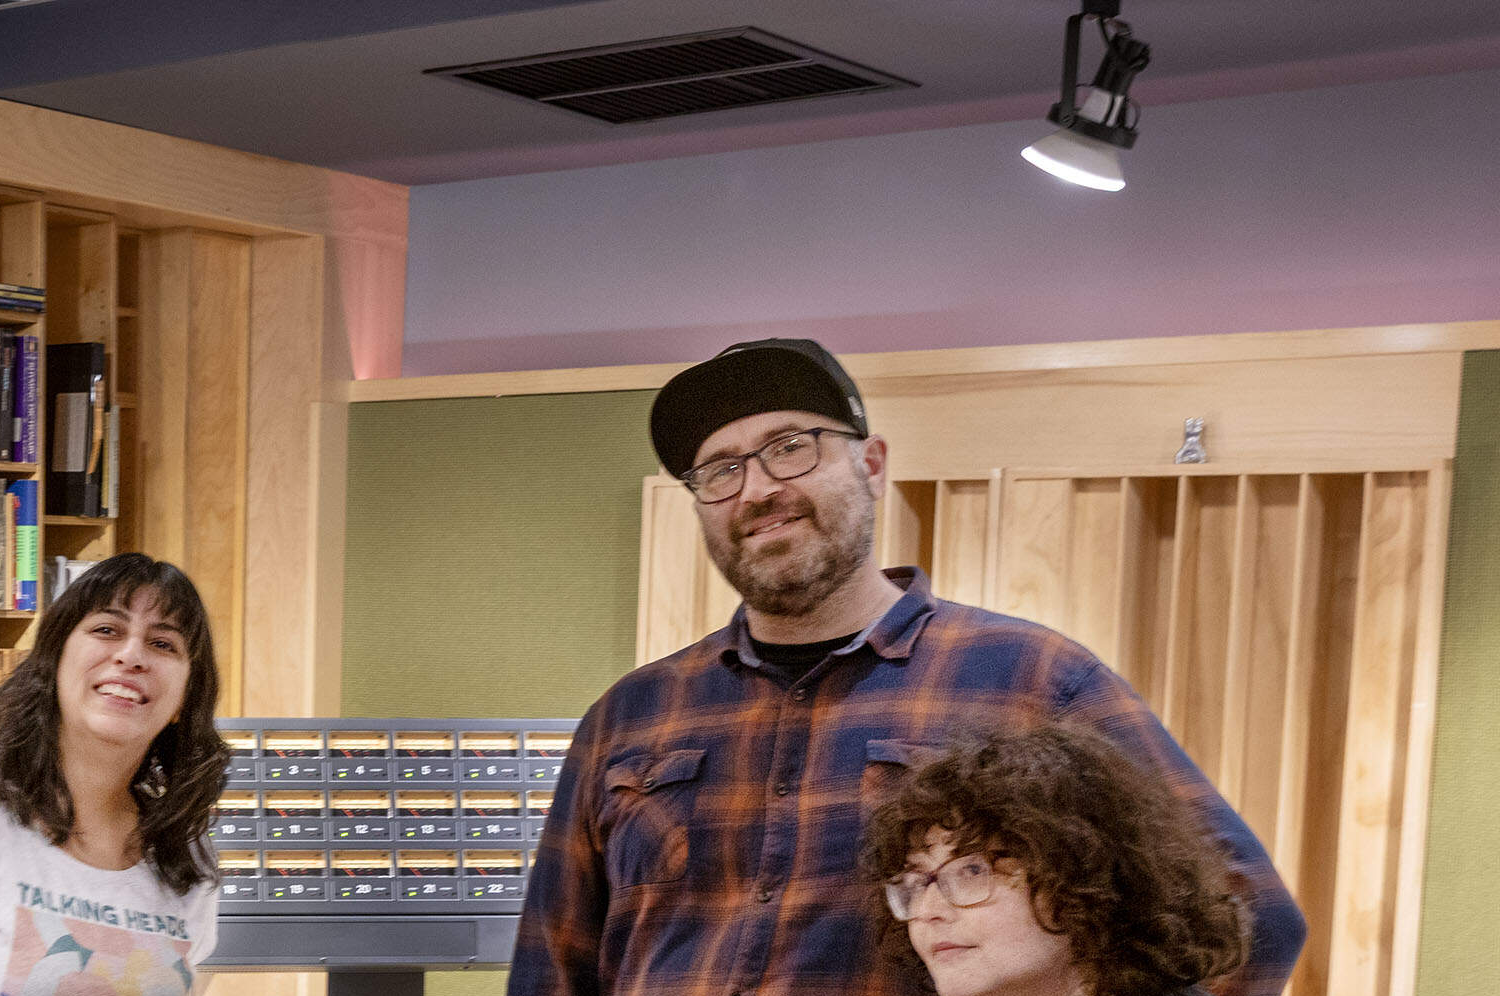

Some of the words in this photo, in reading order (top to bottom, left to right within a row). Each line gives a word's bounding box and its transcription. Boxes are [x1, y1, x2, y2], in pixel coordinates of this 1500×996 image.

[288, 765, 300, 775] 3
[354, 765, 366, 775] 4
[420, 765, 432, 775] 5
[486, 765, 498, 775] 6
[220, 824, 237, 834] 10
[288, 824, 301, 834] 11
[354, 824, 369, 834] 12
[420, 824, 435, 834] 13
[486, 824, 501, 834] 14
[355, 884, 372, 895] 20
[422, 883, 437, 894] 21
[487, 883, 504, 894] 22
[17, 881, 119, 926] TALKING
